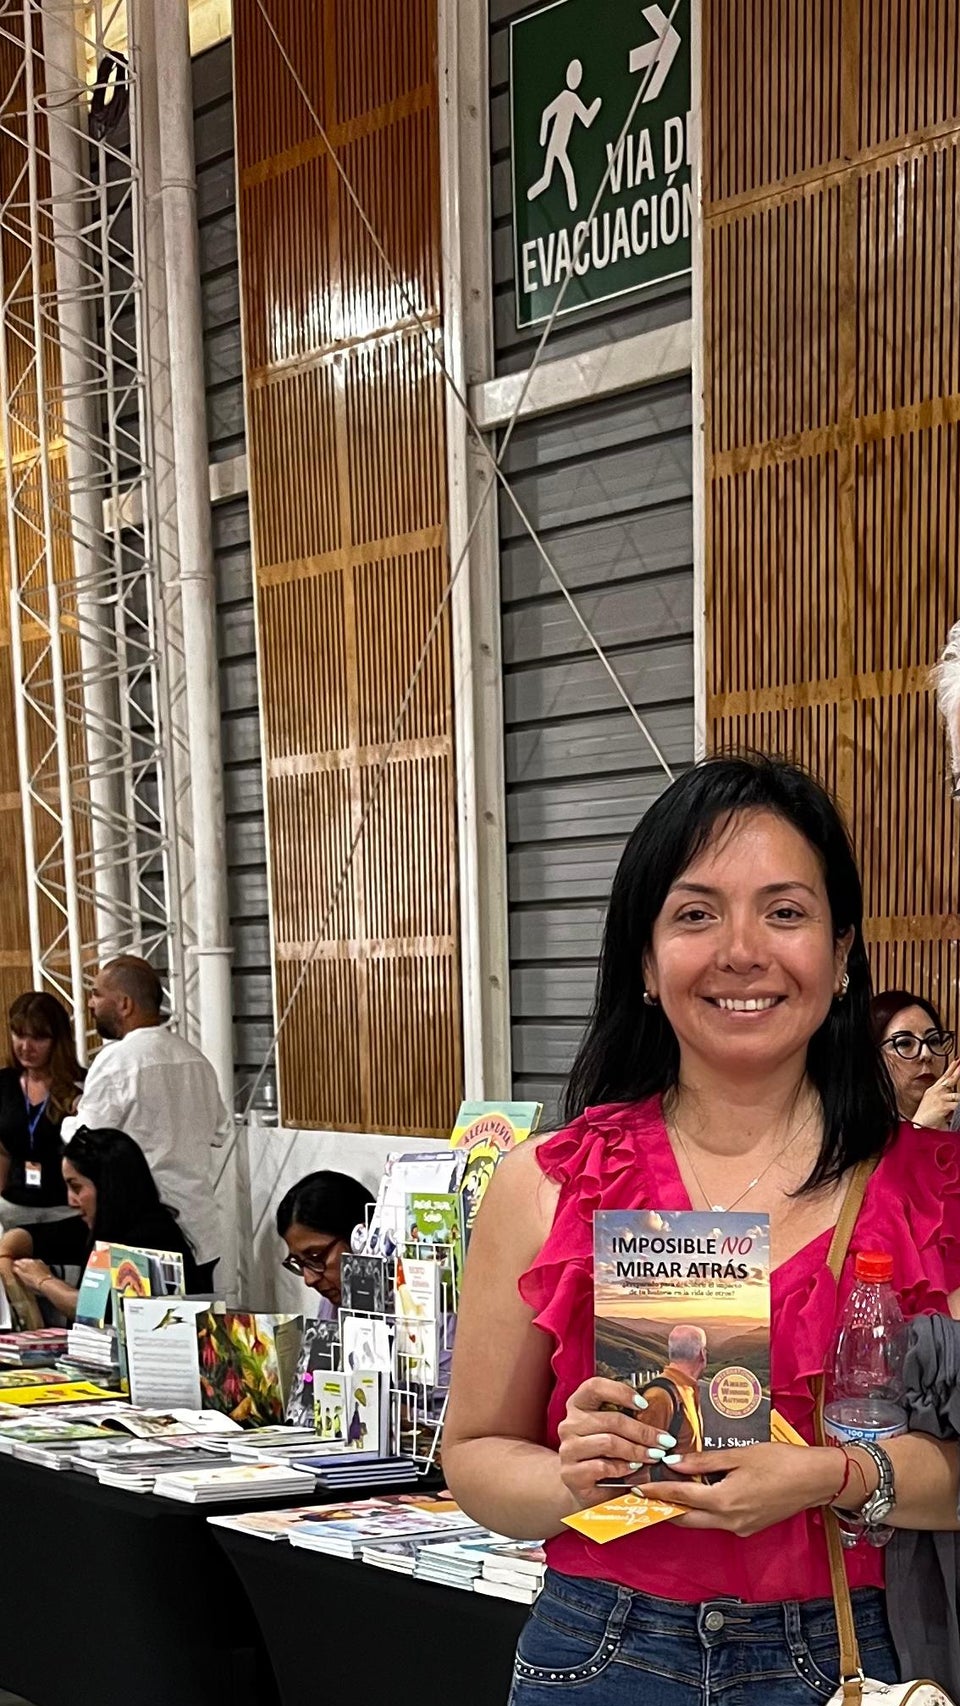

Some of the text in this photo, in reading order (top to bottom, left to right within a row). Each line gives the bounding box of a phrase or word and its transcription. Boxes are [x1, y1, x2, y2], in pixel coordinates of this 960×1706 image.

[606, 128, 656, 194] VIA
[522, 174, 692, 294] EVACUACIÓN
[612, 1236, 753, 1255] IMPOSIBLE NO
[616, 1259, 748, 1279] MIRAR ATRÁS
[704, 1436, 715, 1447] R.
[717, 1436, 726, 1448] J.
